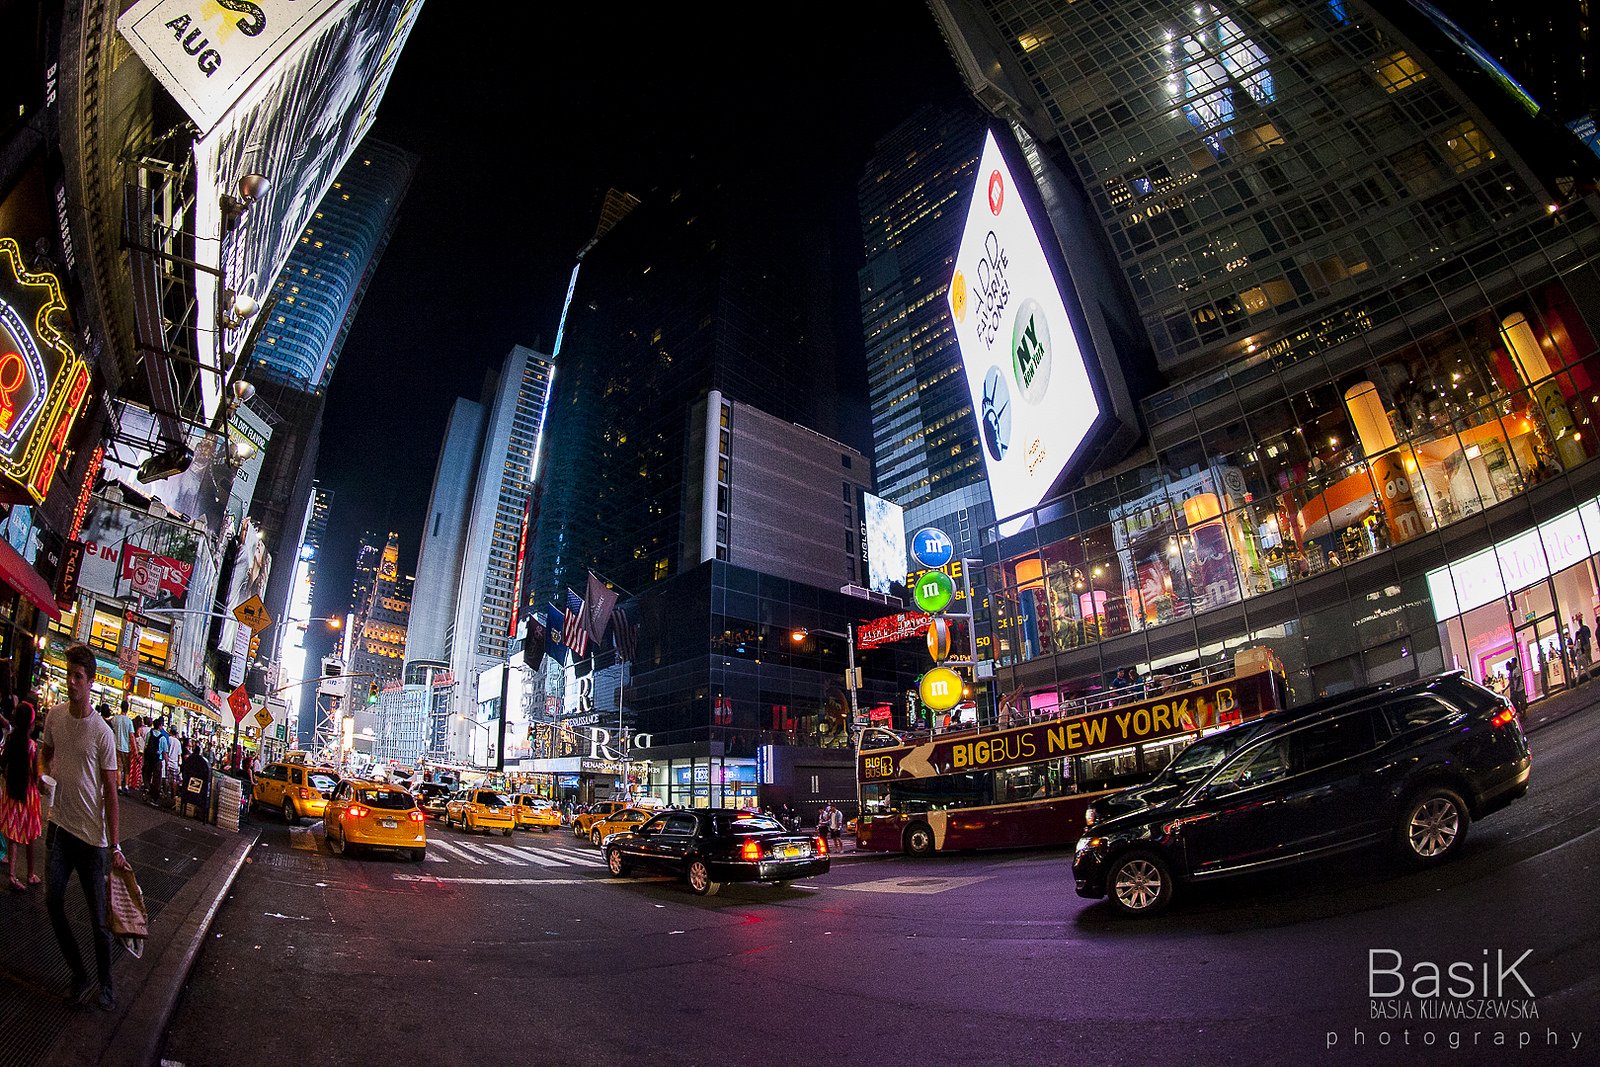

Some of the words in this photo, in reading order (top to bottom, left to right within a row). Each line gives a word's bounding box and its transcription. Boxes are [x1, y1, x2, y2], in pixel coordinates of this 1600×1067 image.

[164, 14, 222, 78] AUG
[46, 62, 57, 107] BAR
[56, 185, 76, 271] BRASSERIE
[972, 230, 998, 314] ADD
[976, 248, 1009, 342] FAVORITE
[985, 279, 1011, 351] ICONS!
[1016, 313, 1038, 374] NY
[1023, 365, 1036, 389] New
[1031, 341, 1046, 368] York
[36, 371, 87, 498] BAR
[238, 420, 249, 434] DRY
[100, 546, 118, 563] IN
[925, 537, 943, 553] m
[63, 548, 79, 592] HAPPY
[511, 558, 524, 619] STREET
[922, 582, 940, 599] m
[976, 636, 990, 647] 50
[175, 698, 204, 714] SMILERS
[575, 678, 593, 713] R
[930, 680, 948, 697] m
[566, 714, 600, 728] RENAISSANCE
[1047, 717, 1107, 753] NEW
[1116, 698, 1190, 740] YORK
[588, 727, 620, 761] R
[582, 761, 623, 772] RENAISSANCE
[865, 757, 881, 769] BIG
[865, 768, 881, 779] BUS
